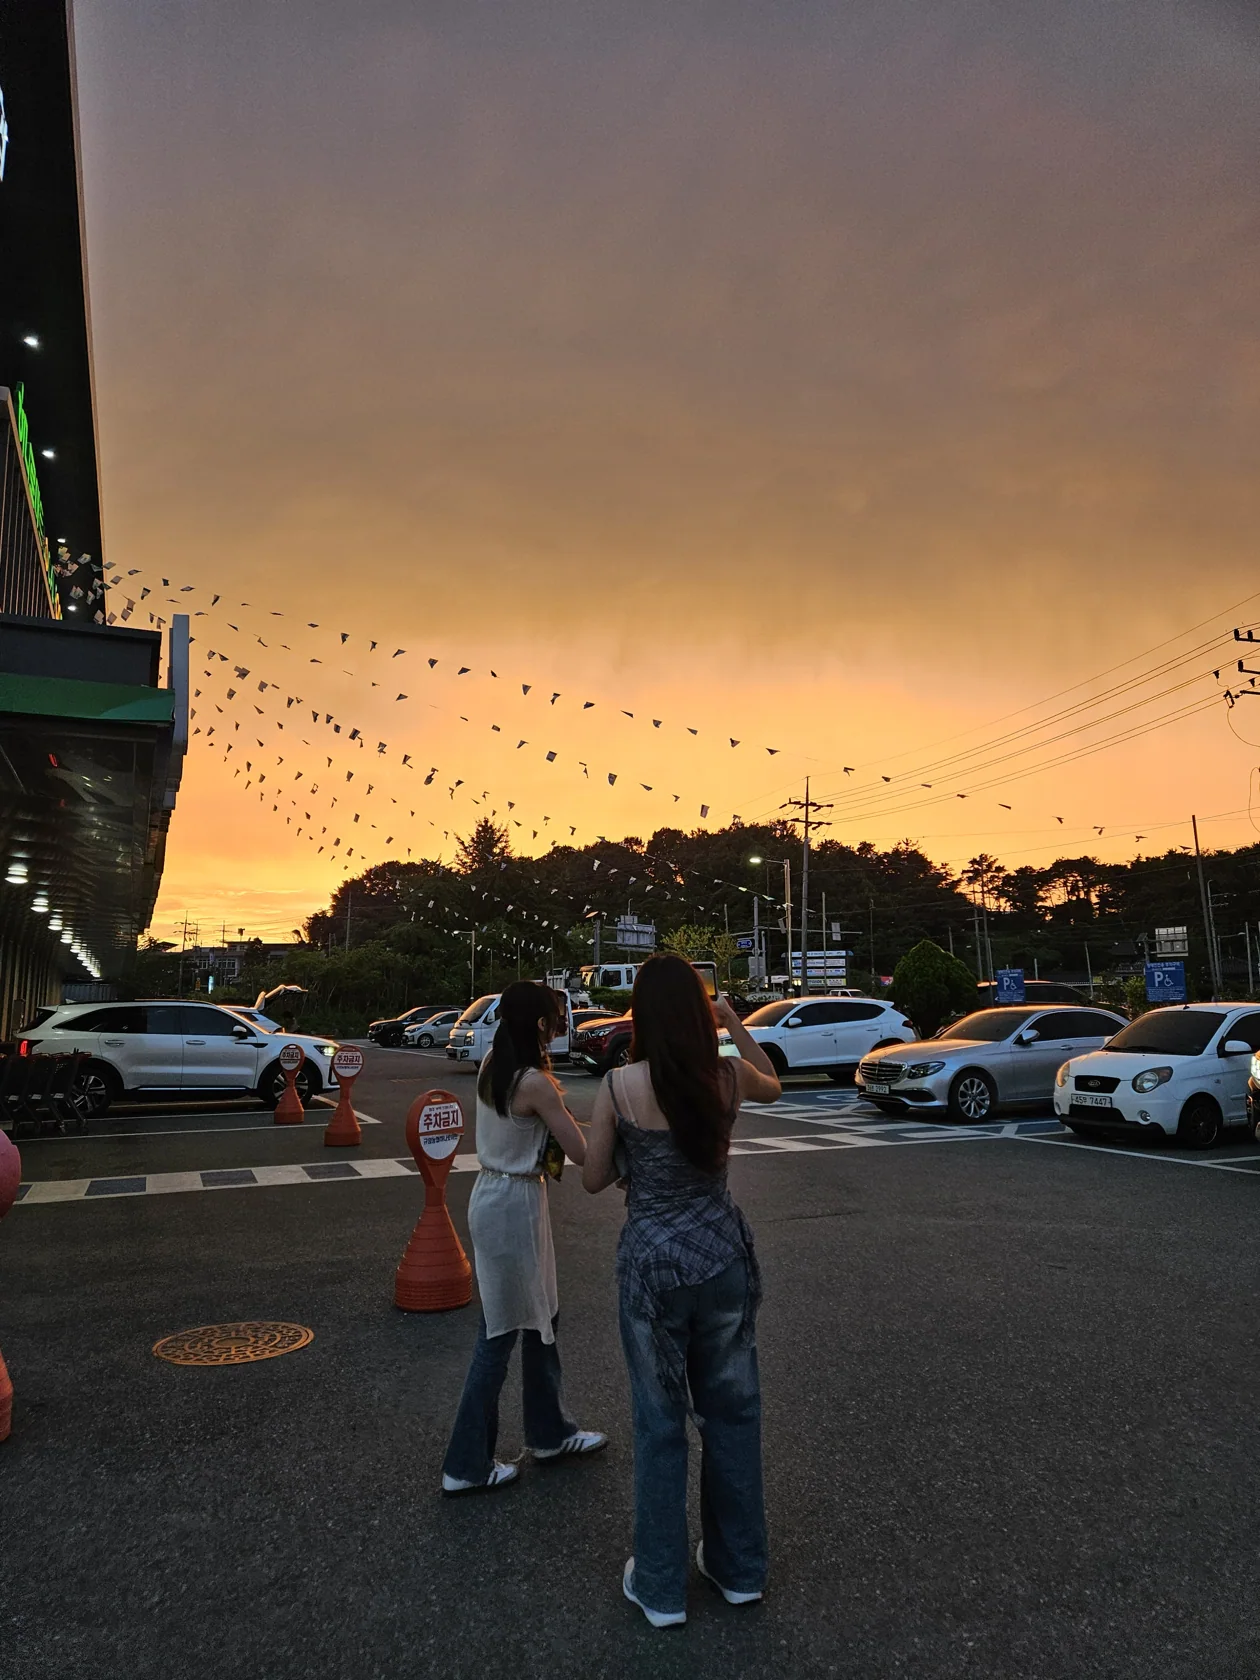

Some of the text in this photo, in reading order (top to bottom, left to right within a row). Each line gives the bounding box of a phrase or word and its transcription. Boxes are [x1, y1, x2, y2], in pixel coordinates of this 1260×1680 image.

[1003, 977, 1010, 990] P
[1154, 972, 1163, 987] P
[337, 1055, 360, 1063] 주차금지
[1090, 1097, 1107, 1106] 7447
[424, 1110, 458, 1130] 주차금지
